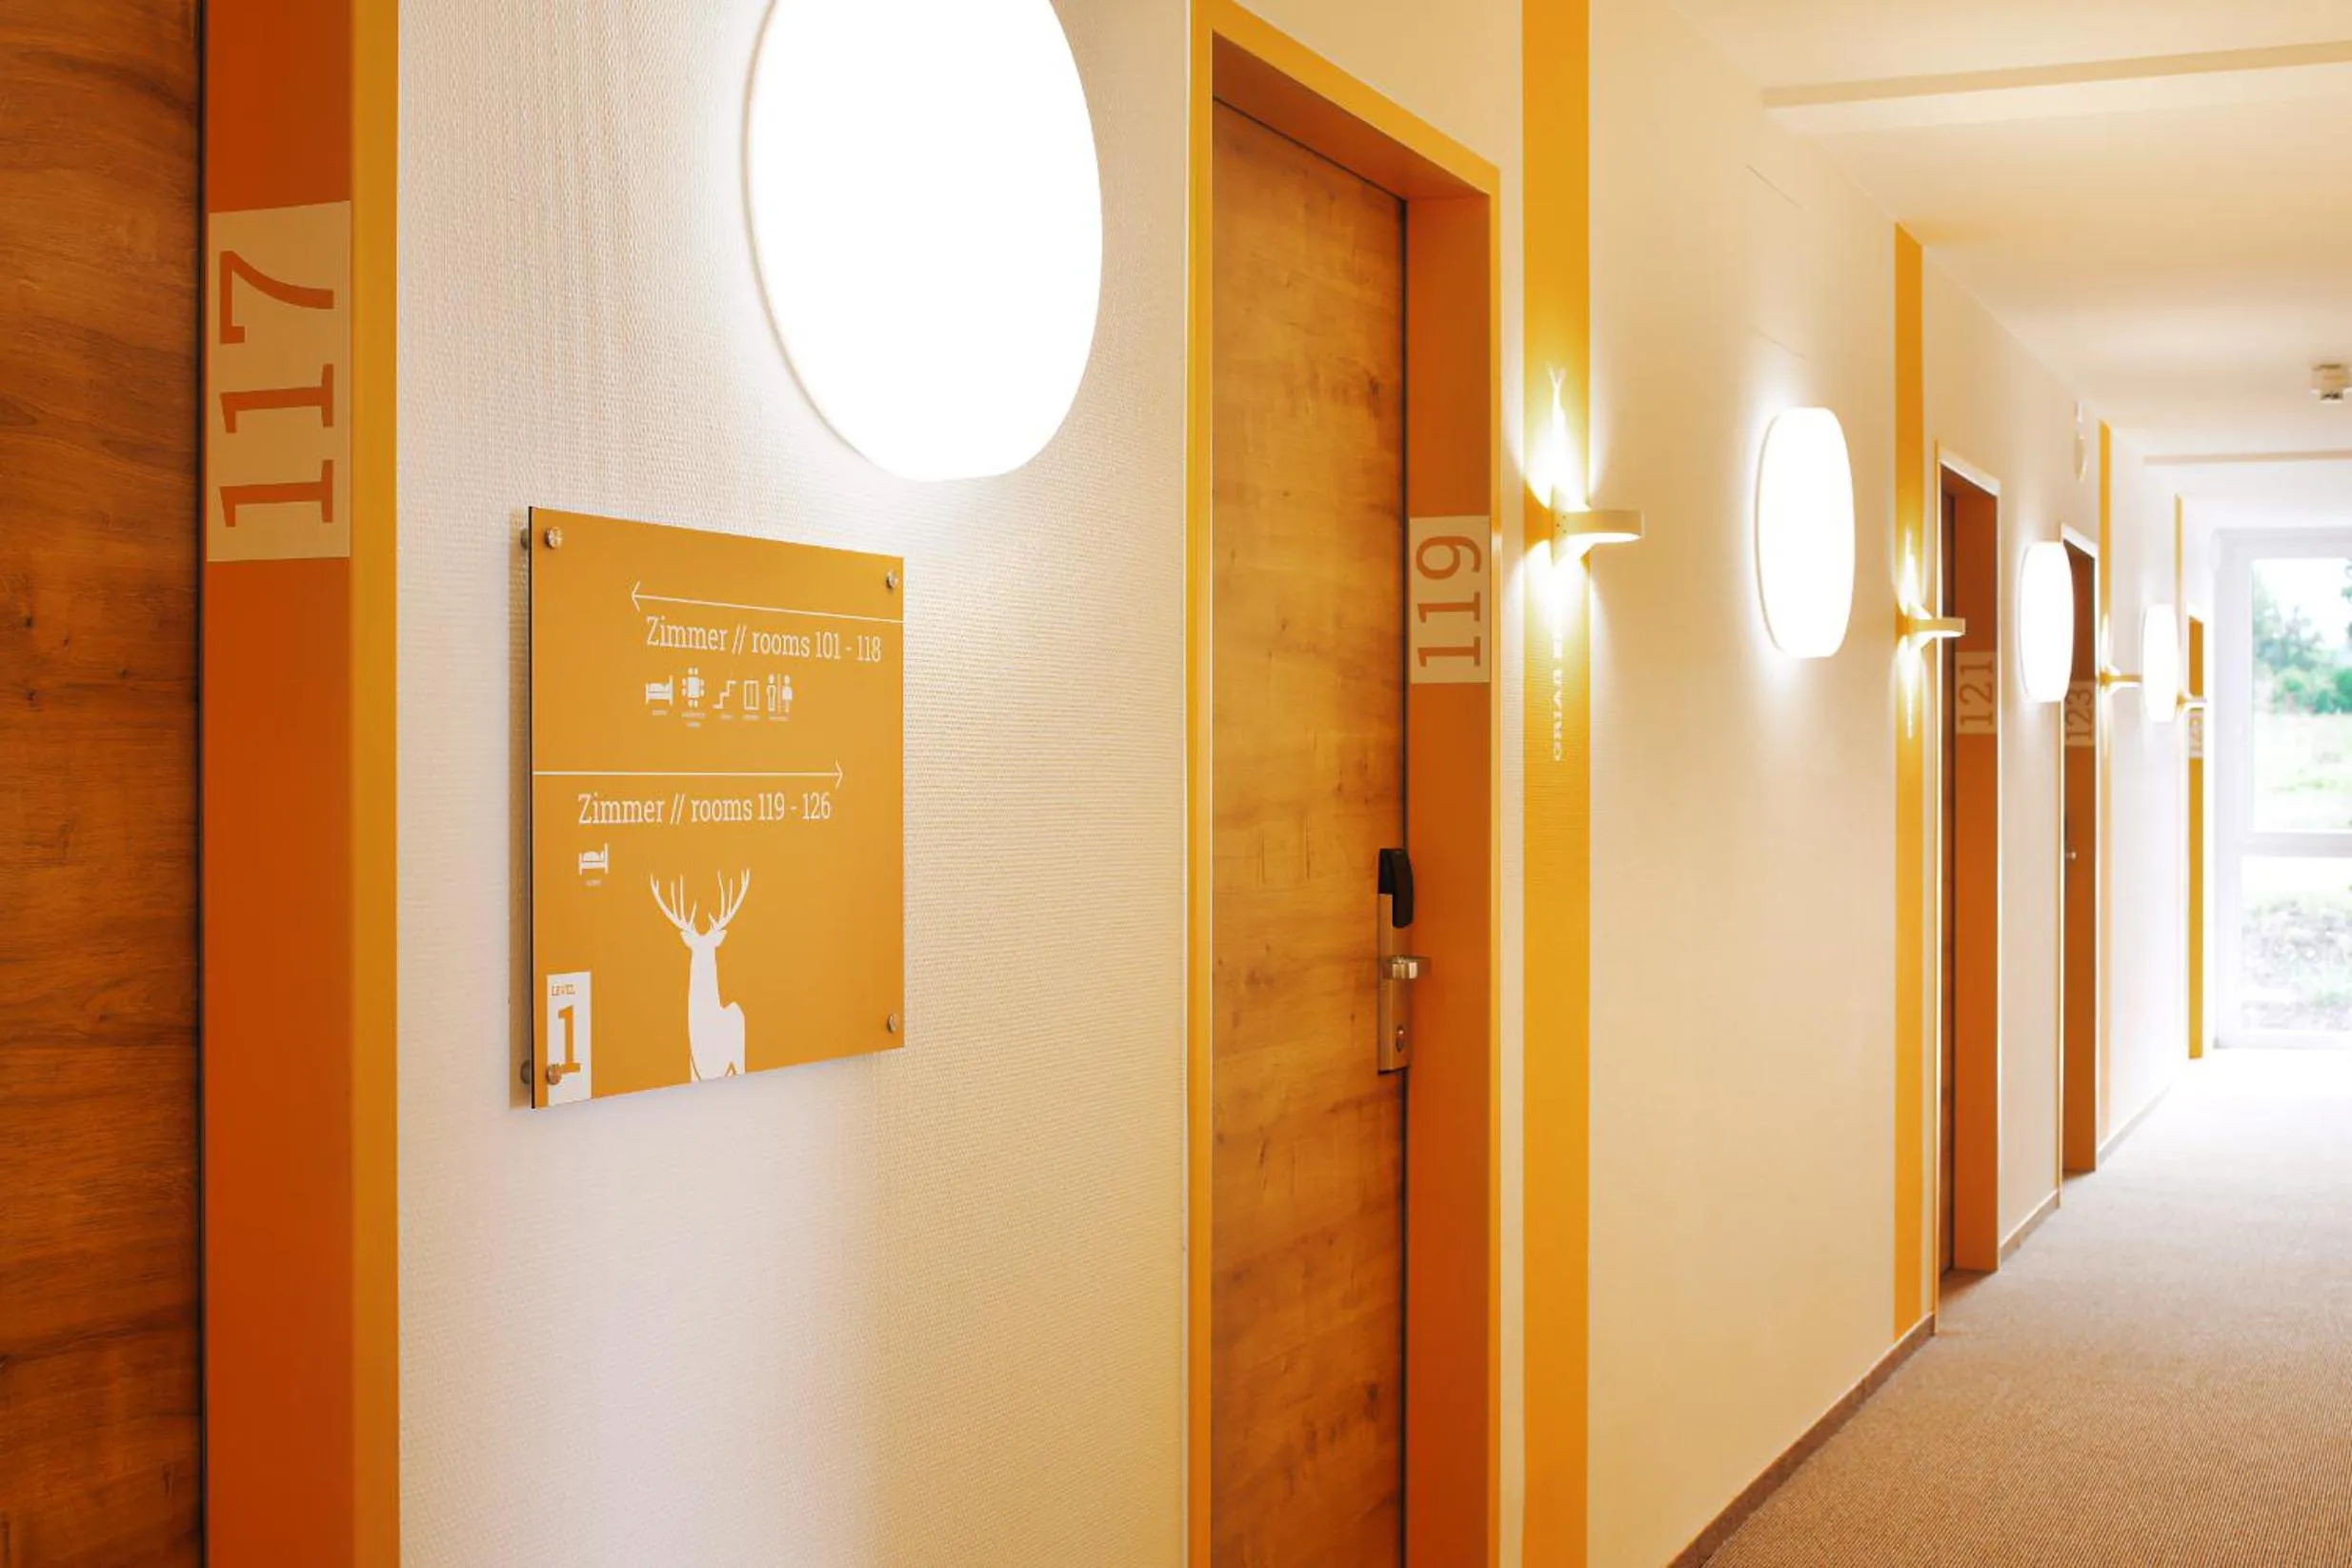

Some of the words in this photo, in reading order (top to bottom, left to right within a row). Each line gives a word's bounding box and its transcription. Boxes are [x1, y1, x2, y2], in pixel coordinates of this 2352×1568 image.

[219, 250, 334, 528] 117
[1415, 534, 1482, 668] 119
[646, 615, 728, 651] Zimmer
[732, 624, 747, 655] //
[752, 632, 811, 658] rooms
[815, 631, 841, 660] 101
[856, 634, 881, 663] 118
[1959, 659, 1993, 727] 121
[2066, 689, 2093, 740] 123
[577, 793, 665, 825] Zimmer
[670, 793, 686, 825] //
[691, 798, 753, 823] rooms
[757, 792, 786, 821] 119
[802, 792, 833, 822] 126
[557, 1004, 581, 1074] 1
